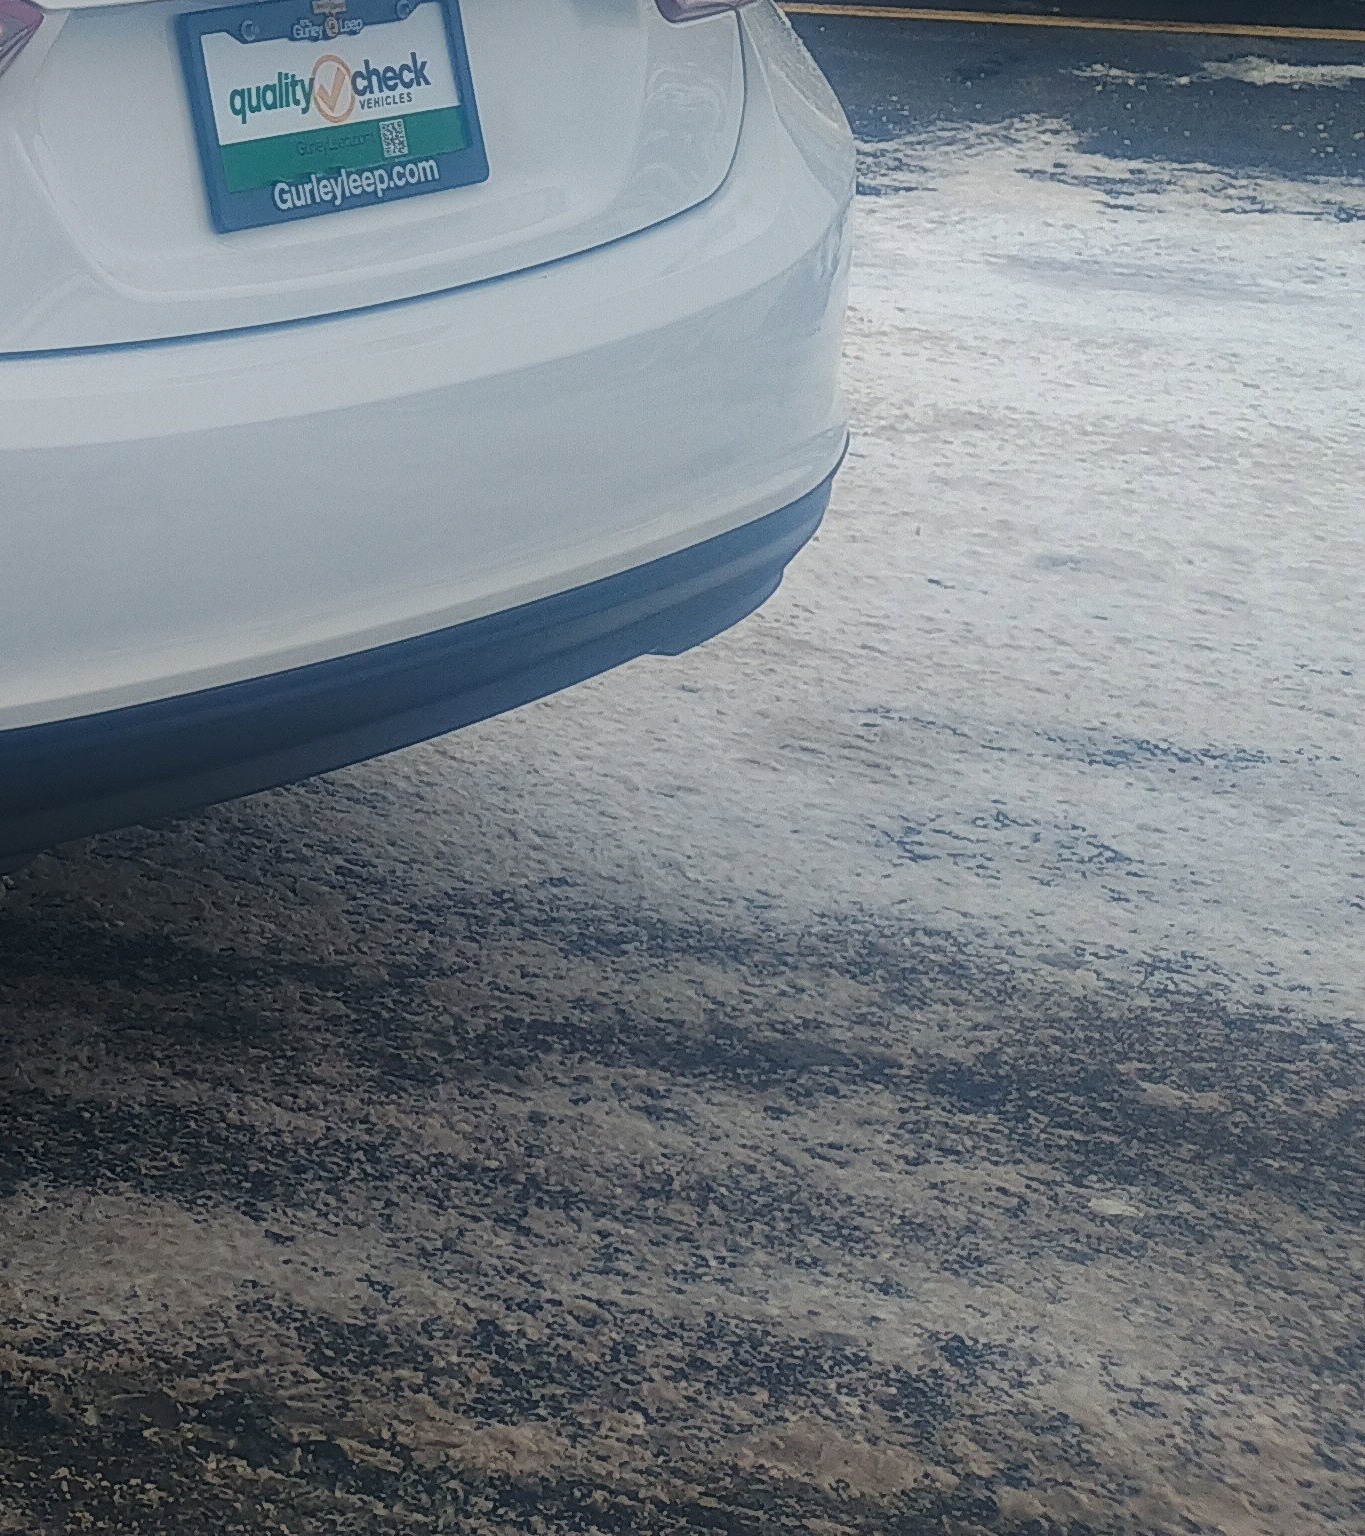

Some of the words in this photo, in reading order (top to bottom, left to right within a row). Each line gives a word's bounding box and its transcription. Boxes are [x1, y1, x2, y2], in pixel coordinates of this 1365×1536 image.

[230, 72, 314, 124] quality
[352, 52, 432, 97] check
[359, 92, 413, 110] VEHICLES
[274, 158, 439, 210] Gurleyleep.com
